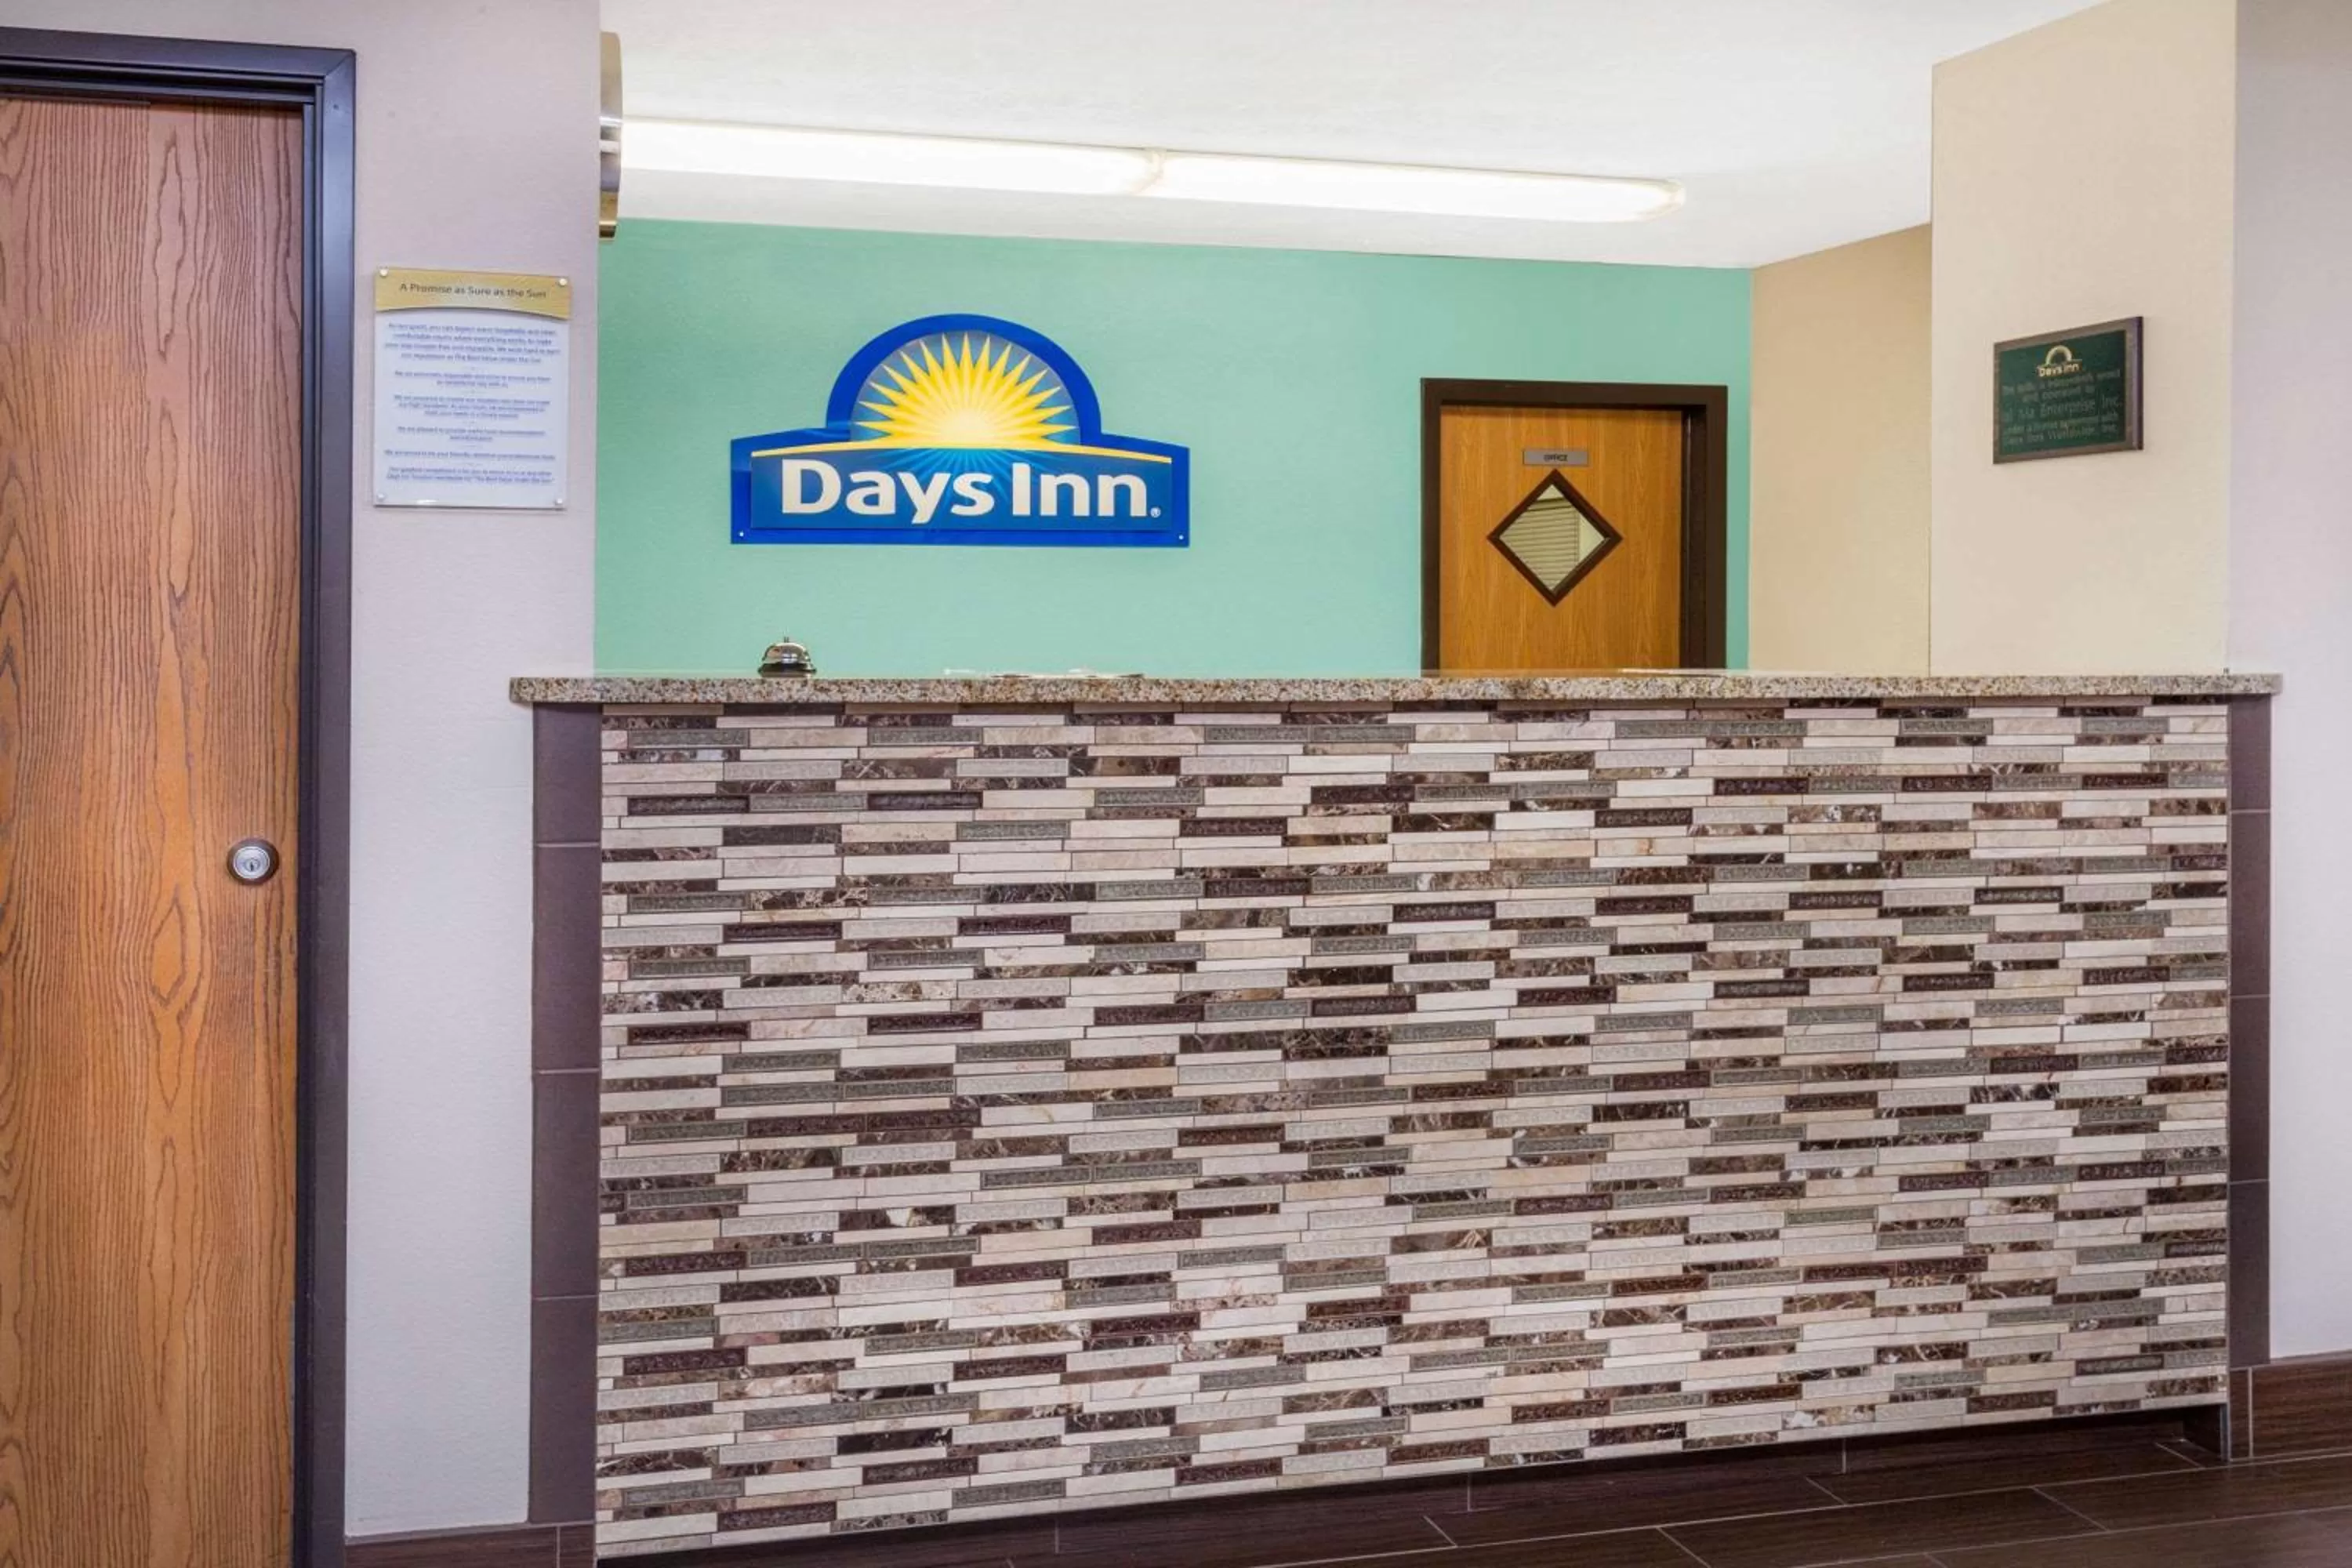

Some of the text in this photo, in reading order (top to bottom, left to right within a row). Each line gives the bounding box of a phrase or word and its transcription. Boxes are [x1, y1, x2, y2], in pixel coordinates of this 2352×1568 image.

[400, 283, 408, 292] A
[410, 283, 452, 294] Promise
[468, 285, 490, 296] Sure
[493, 288, 504, 296] as
[506, 287, 523, 297] the
[526, 289, 546, 298] Sun
[2038, 363, 2080, 378] Days Inn
[782, 458, 994, 524] Days
